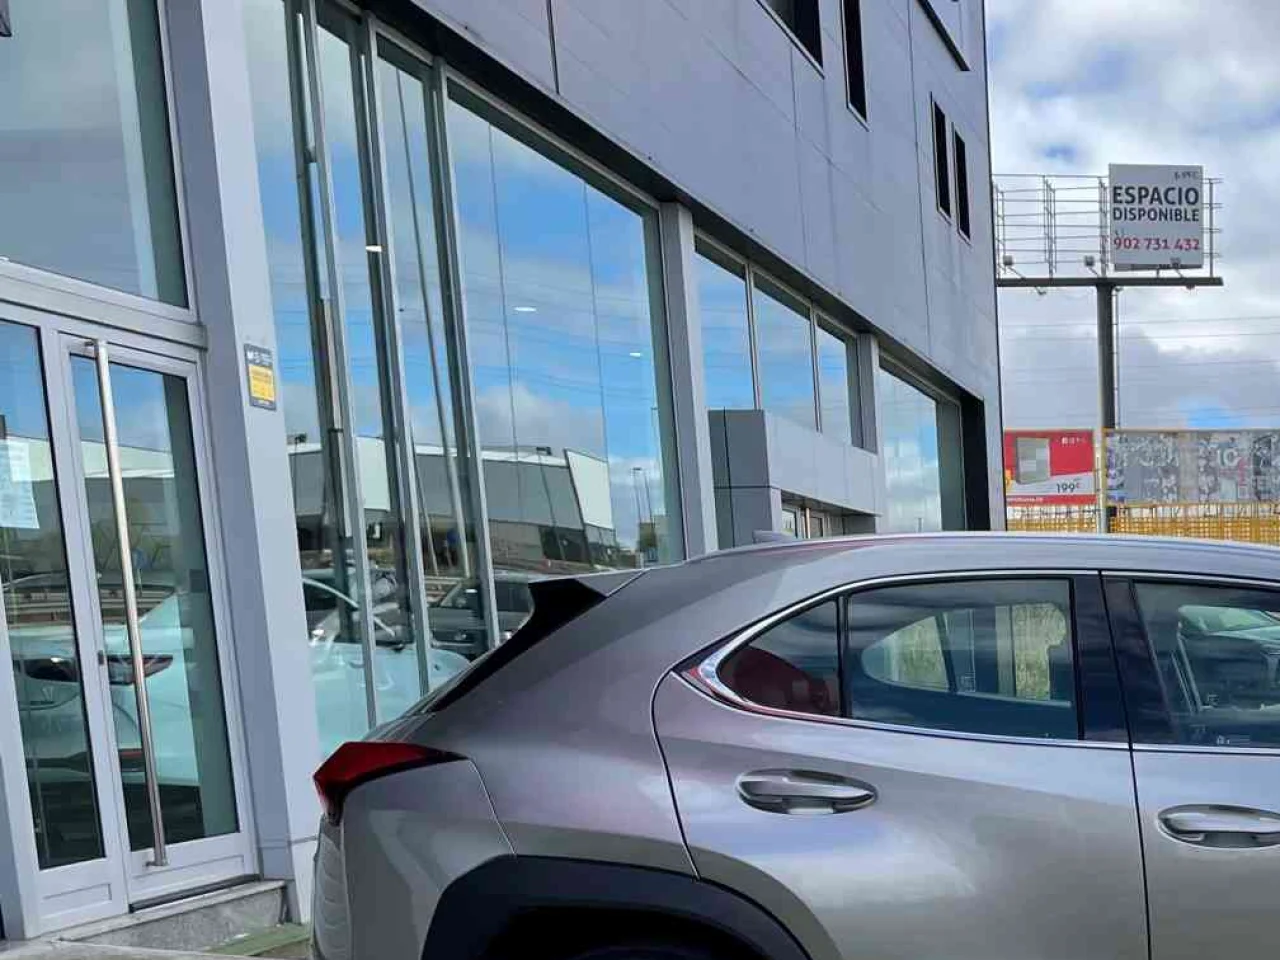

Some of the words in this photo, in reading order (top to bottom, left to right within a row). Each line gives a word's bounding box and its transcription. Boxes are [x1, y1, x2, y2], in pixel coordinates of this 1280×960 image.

[1113, 186, 1199, 205] ESPACIO
[1113, 207, 1199, 222] DISPONIBLE
[1114, 237, 1140, 250] 902
[1144, 237, 1170, 251] 731
[1174, 238, 1200, 251] 432
